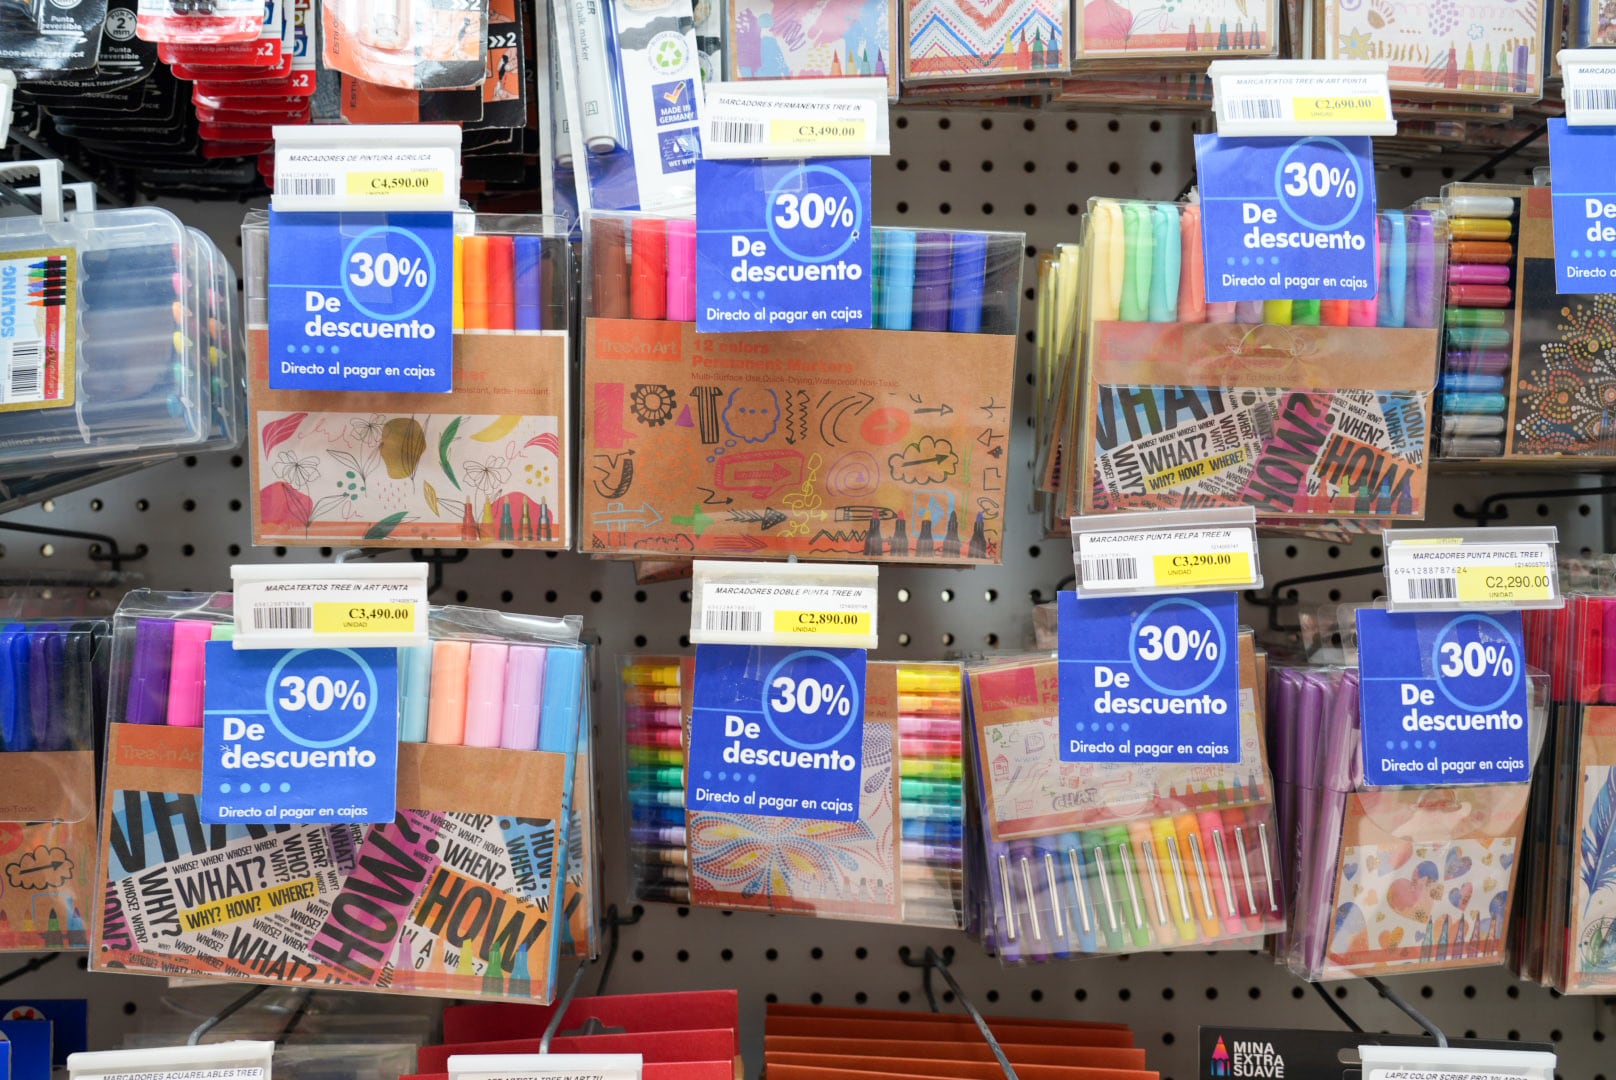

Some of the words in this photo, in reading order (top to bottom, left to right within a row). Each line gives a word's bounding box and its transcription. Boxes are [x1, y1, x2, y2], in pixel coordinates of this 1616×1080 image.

[117, 18, 126, 29] 2
[257, 43, 274, 56] x2
[580, 29, 590, 61] marker
[661, 105, 681, 116] MADE
[719, 98, 772, 108] MARCADORES
[774, 102, 830, 110] PERMANENTES
[660, 112, 694, 124] GERMANY
[371, 178, 429, 189] C4,590.00
[1284, 162, 1356, 198] 30%
[775, 193, 854, 229] 30%
[1242, 203, 1277, 224] De
[1585, 198, 1616, 218] De
[731, 235, 767, 257] De
[1243, 226, 1365, 250] descuento
[350, 252, 428, 288] 30%
[731, 259, 862, 282] descuento
[1222, 274, 1265, 286] Directo
[1269, 272, 1280, 285] al
[1285, 276, 1320, 289] pagar
[1323, 277, 1336, 287] en
[1340, 277, 1367, 291] cajas
[1567, 267, 1606, 278] Directo
[1, 265, 17, 338] SOLVING
[305, 291, 341, 313] De
[305, 314, 436, 339] descuento
[707, 307, 750, 320] Directo
[754, 307, 765, 320] al
[769, 309, 808, 323] pagar
[811, 309, 827, 319] en
[831, 307, 863, 322] cajas
[694, 339, 713, 352] 12
[719, 341, 769, 354] colors
[281, 361, 325, 375] Directo
[328, 362, 340, 375] al
[344, 366, 382, 378] pagar
[385, 366, 400, 376] en
[403, 365, 436, 379] cajas
[692, 354, 782, 370] Permanent
[788, 358, 854, 373] Markers
[1220, 415, 1241, 449] WHO?
[1338, 413, 1384, 446] WHEN?
[1140, 433, 1209, 474] WHAT?
[1242, 393, 1336, 512] HOW?
[1149, 474, 1175, 490] WHY?
[1179, 464, 1205, 481] HOW?
[1209, 450, 1244, 471] WHERE?
[1089, 534, 1144, 544] MARCADORES
[1146, 533, 1172, 541] PUNTA
[1172, 554, 1231, 567] C3,290.00
[1412, 552, 1466, 560] MARCADORES
[265, 584, 328, 592] MARCATEXTOS
[715, 587, 771, 595] MARCADORES
[1486, 575, 1550, 588] C2,290.00
[349, 608, 408, 620] C3,490.00
[799, 613, 858, 625] C2,890.00
[1138, 625, 1218, 661] 30%
[1440, 641, 1513, 678] 30%
[1094, 666, 1130, 688] De
[279, 675, 366, 711] 30%
[771, 677, 850, 716] 30%
[1094, 691, 1227, 715] descuento
[1401, 683, 1435, 706] De
[223, 717, 265, 741] De
[725, 715, 761, 738] De
[1402, 708, 1523, 732] descuento
[221, 744, 376, 769] descuento
[723, 740, 856, 771] descuento
[1070, 740, 1115, 753] Directo
[1118, 740, 1131, 753] al
[1134, 743, 1173, 757] pagar
[1177, 744, 1193, 754] en
[1196, 742, 1229, 757] cajas
[1381, 758, 1424, 772] Directo
[1427, 757, 1438, 771] al
[1441, 759, 1476, 774] pagar
[1479, 760, 1493, 770] en
[1496, 756, 1524, 772] cajas
[219, 806, 262, 818] Directo
[265, 806, 277, 817] al
[280, 807, 316, 819] pagar
[319, 808, 334, 816] en
[337, 805, 368, 817] cajas
[696, 788, 740, 804] Directo
[744, 791, 756, 805] al
[759, 796, 798, 810] pagar
[801, 798, 817, 808] en
[821, 798, 853, 814] cajas
[430, 814, 457, 833] WHERE?
[458, 828, 483, 846] WHAT?
[172, 861, 198, 874] WHOSE?
[201, 853, 224, 867] WHEN?
[226, 846, 252, 860] WHOSE?
[254, 839, 277, 852] WHEN?
[283, 834, 310, 880] WHO?
[307, 829, 328, 868] WHEN?
[270, 850, 290, 883] WHY?
[443, 839, 507, 887] WHEN?
[175, 856, 267, 908] WHAT?
[139, 867, 182, 938] WHY?
[186, 906, 221, 930] WHY?
[226, 895, 261, 918] HOW?
[268, 882, 315, 907] WHERE?
[311, 812, 439, 980] HOW?
[414, 868, 547, 974] HOW
[228, 926, 317, 981] WHAT?
[1233, 1041, 1275, 1055] MINA
[1233, 1054, 1285, 1067] EXTRA
[1233, 1065, 1285, 1079] SUAVE
[1385, 1072, 1408, 1080] LAPIZ
